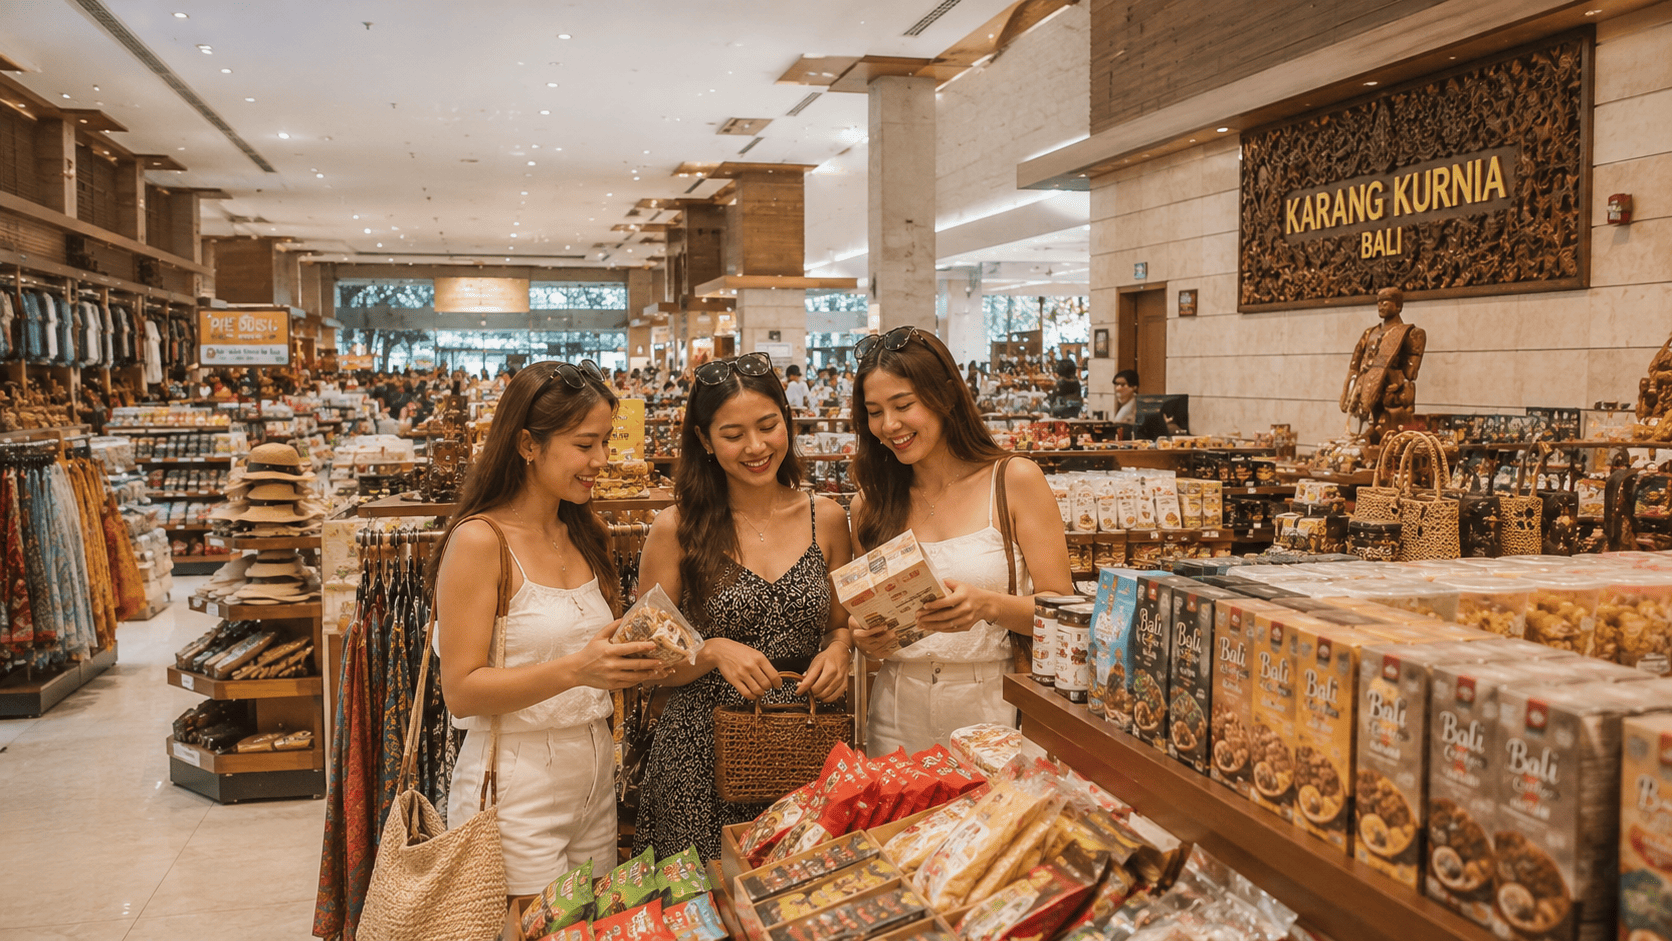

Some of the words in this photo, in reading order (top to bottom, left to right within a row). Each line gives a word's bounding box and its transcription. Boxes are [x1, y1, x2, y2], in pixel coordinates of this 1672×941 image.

[1285, 180, 1384, 235] KARANG
[1393, 154, 1507, 217] KURNIA
[1361, 226, 1402, 259] BALI
[1139, 607, 1162, 637] Bali
[1177, 621, 1202, 654] Bali
[1219, 636, 1247, 668] Bali
[1259, 651, 1289, 685] Bali
[1303, 667, 1339, 704] Bali
[1366, 689, 1407, 729] Bali
[1438, 709, 1486, 754] Bali
[1505, 737, 1560, 786] Bali
